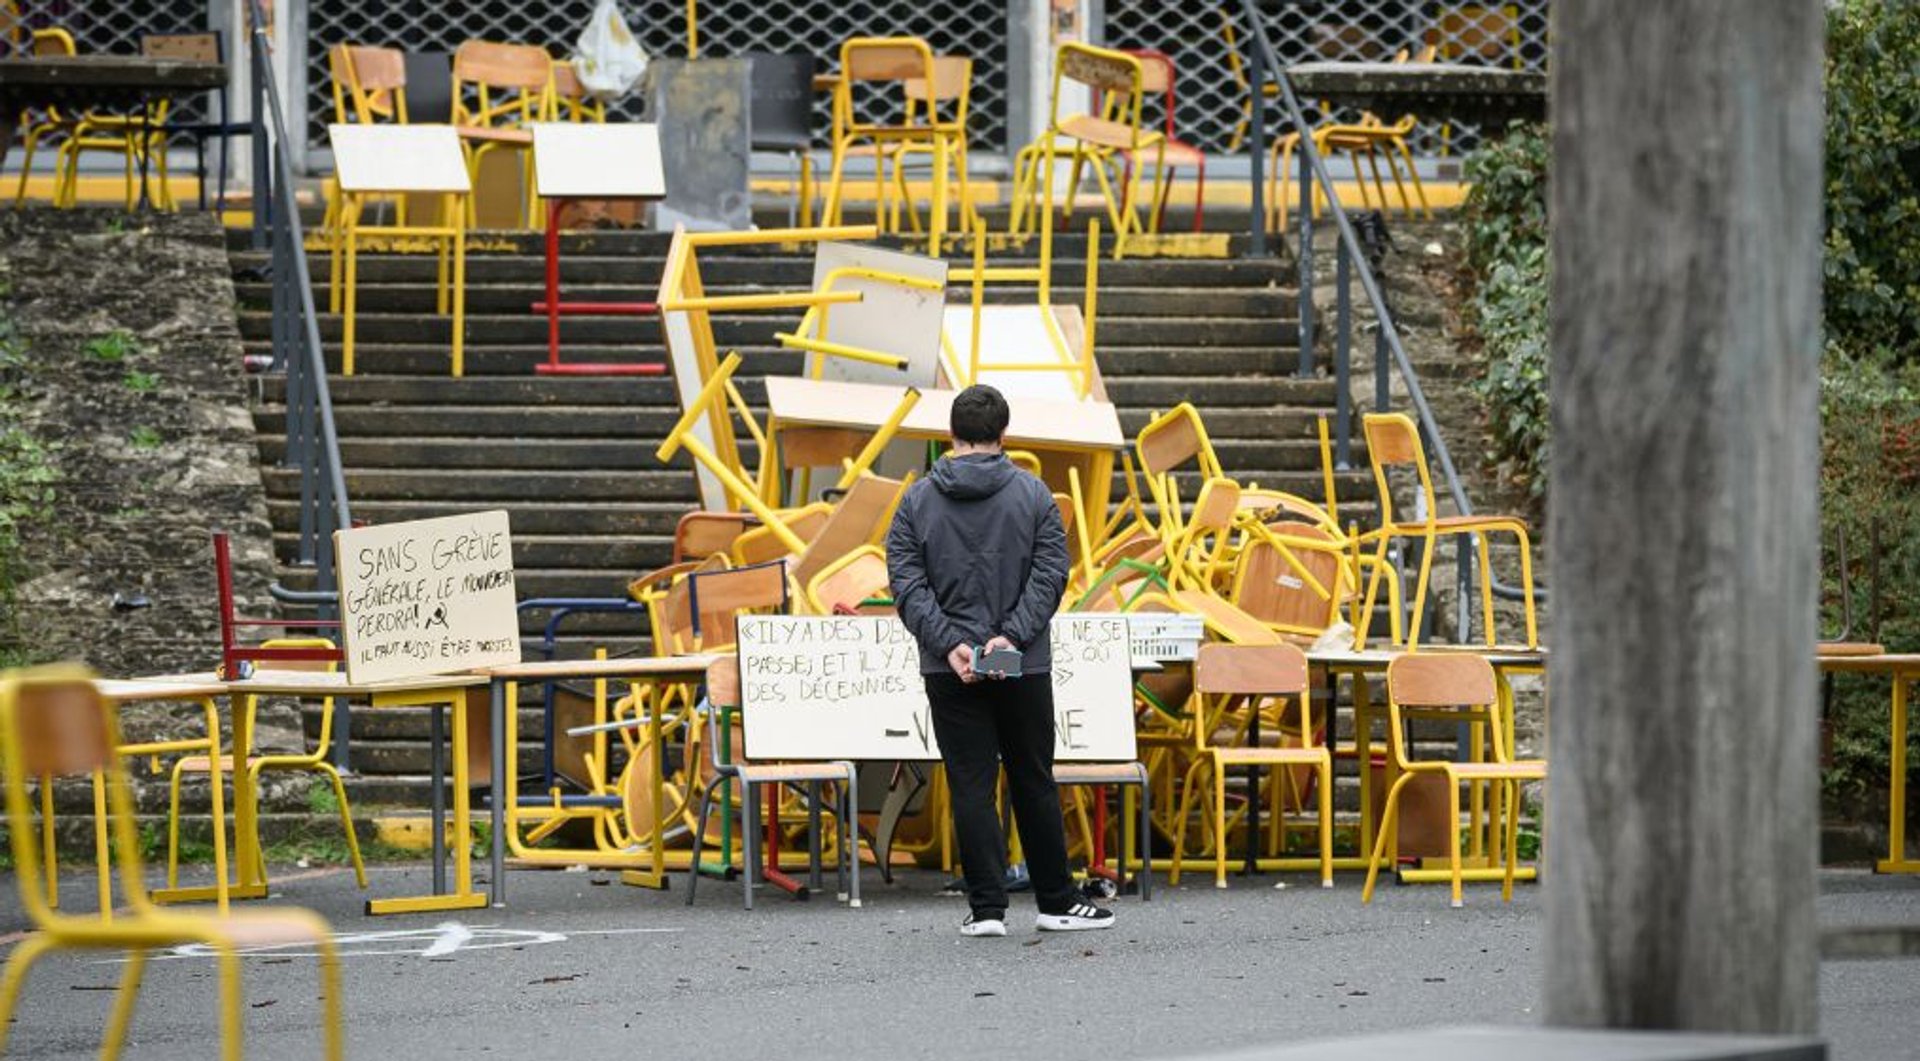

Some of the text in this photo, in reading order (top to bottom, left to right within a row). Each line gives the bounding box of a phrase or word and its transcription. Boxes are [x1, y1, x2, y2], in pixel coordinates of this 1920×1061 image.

[359, 530, 503, 580] SANS GRÈVE
[437, 577, 456, 599] LE
[357, 603, 420, 640] PERDRA!
[820, 618, 863, 642] DES
[1072, 620, 1092, 642] NE
[1100, 620, 1122, 643] SE
[374, 641, 401, 659] FAUT
[441, 636, 472, 658] ÊTRE
[823, 652, 848, 677] ET
[882, 647, 894, 669] Y
[746, 681, 787, 703] DES
